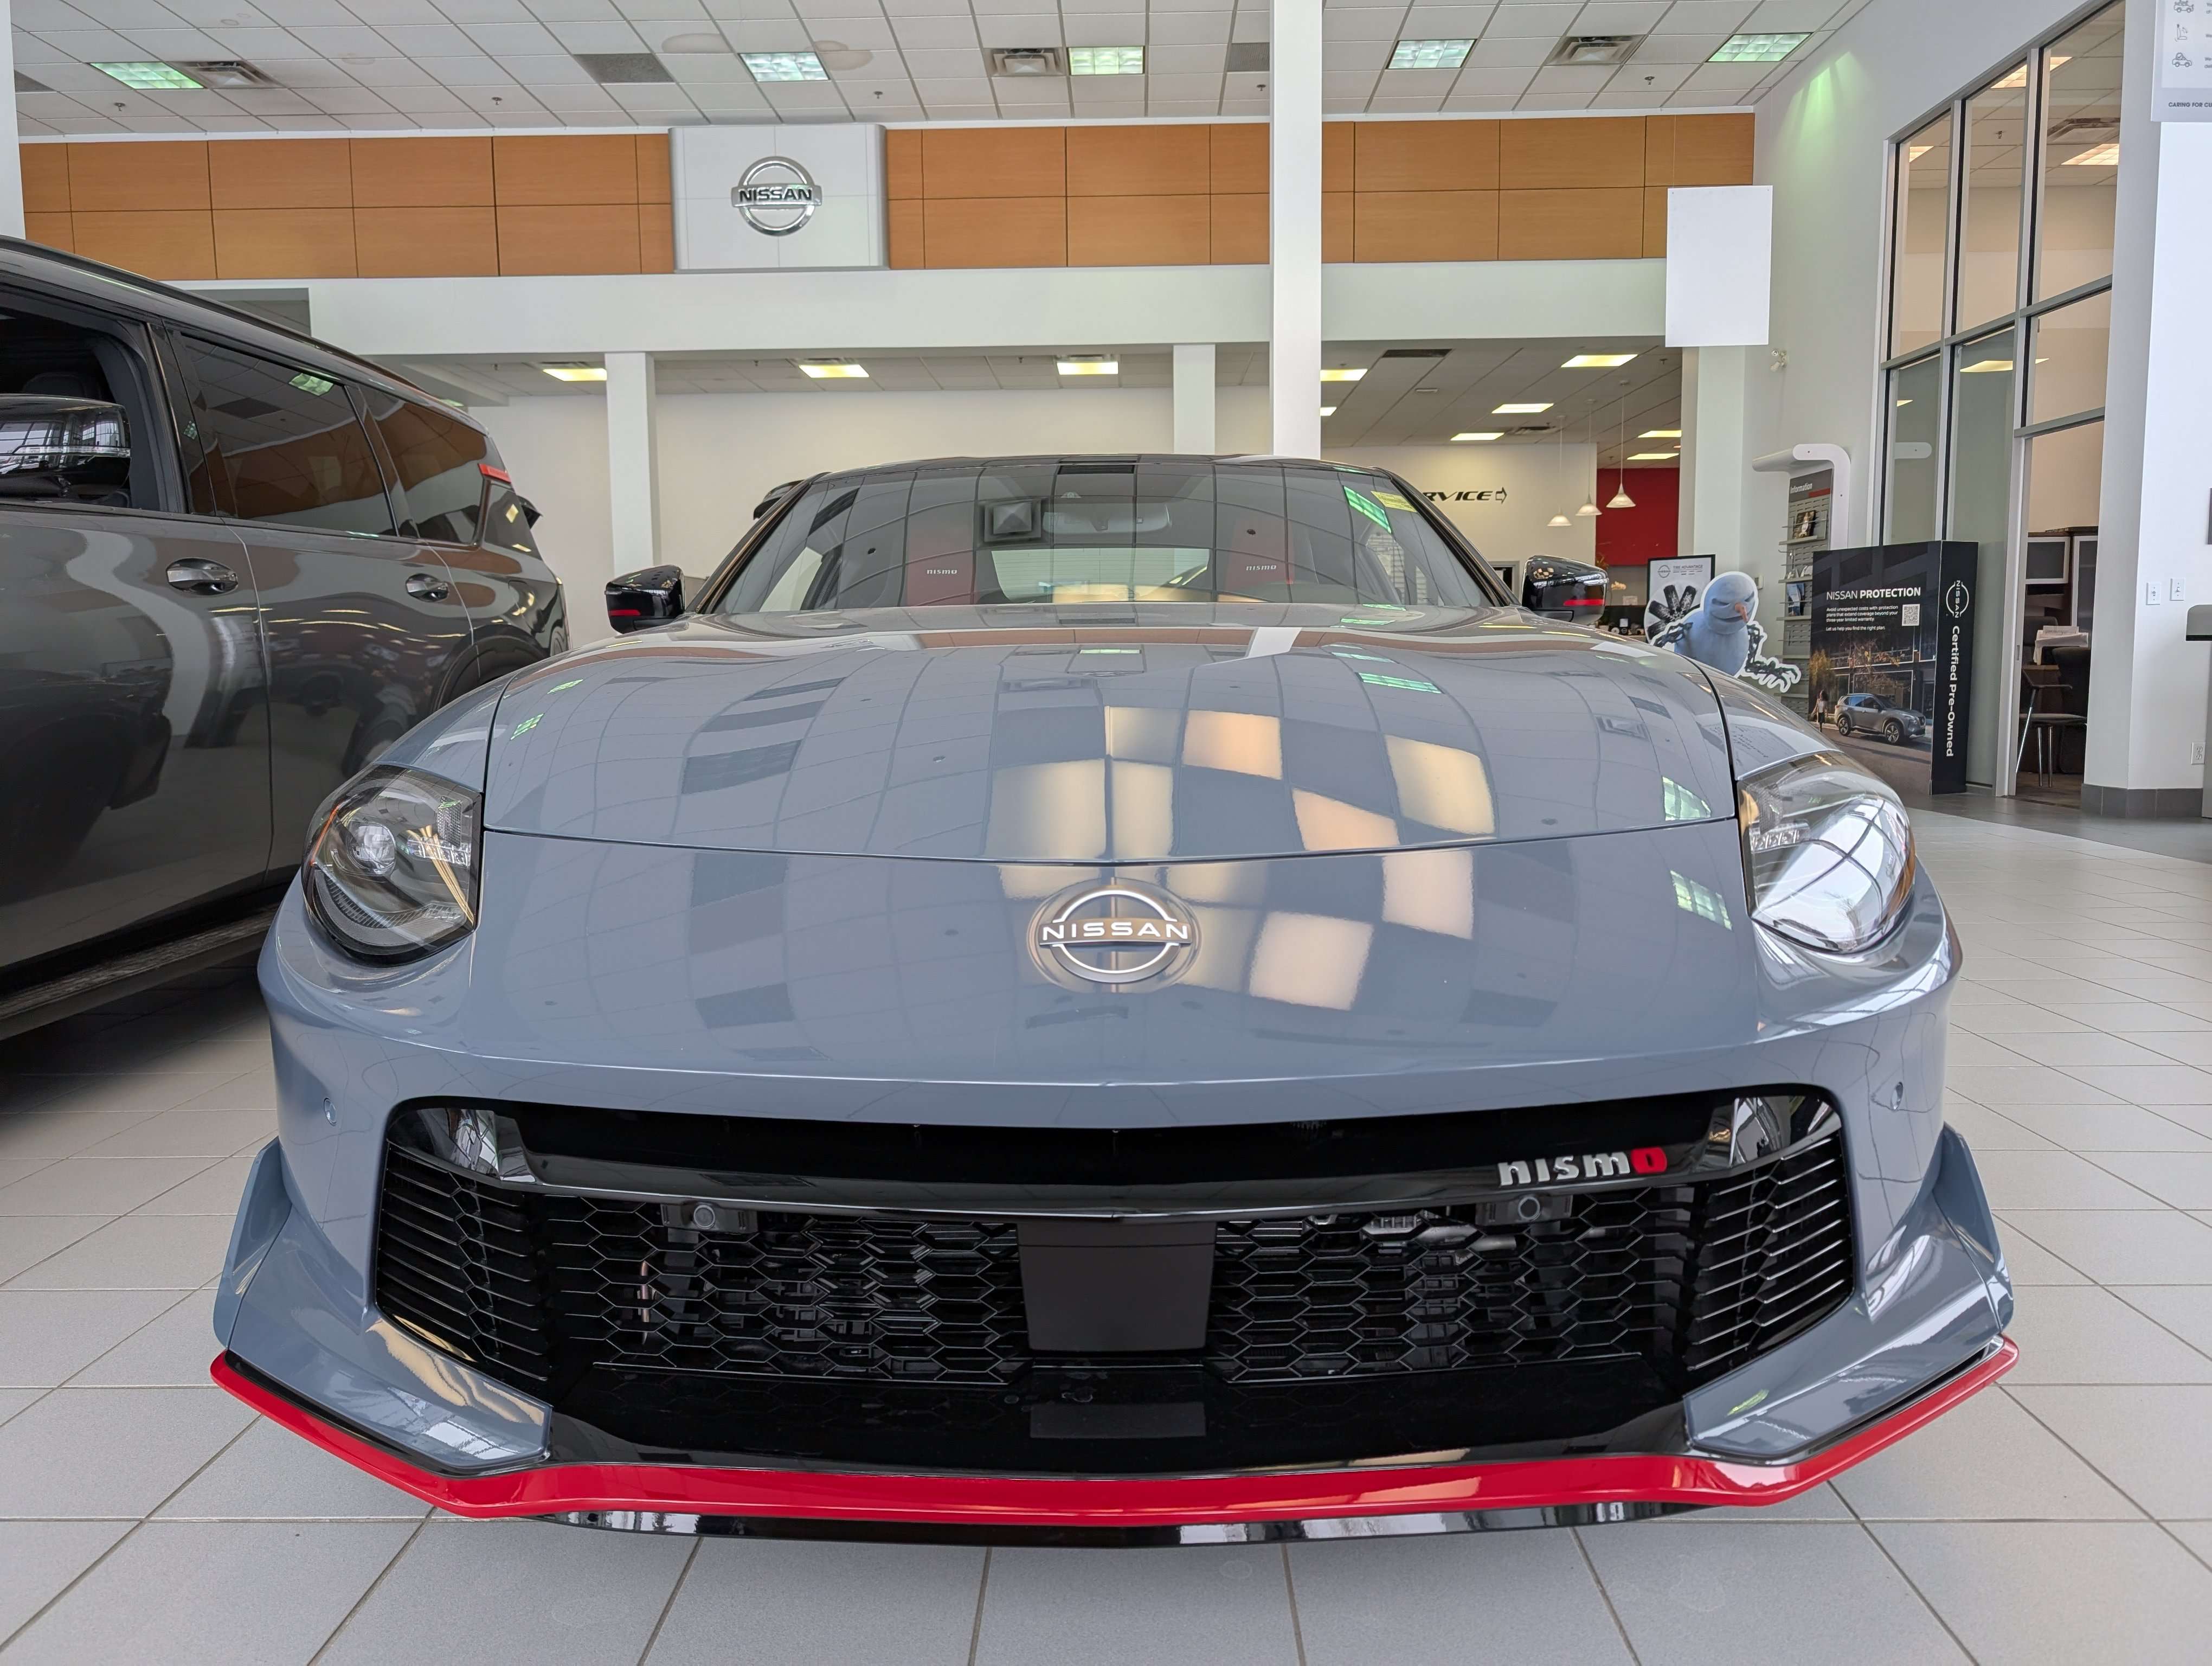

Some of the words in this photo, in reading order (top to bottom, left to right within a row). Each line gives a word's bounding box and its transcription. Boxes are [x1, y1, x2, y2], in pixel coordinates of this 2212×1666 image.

[740, 188, 812, 202] NISSAN
[1790, 482, 1813, 494] Information
[1827, 591, 1857, 600] NISSAN
[1860, 587, 1921, 598] PROTECTION
[1950, 625, 1960, 681] Certified
[1946, 683, 1957, 757] Pre-Owned
[1043, 922, 1188, 941] NISSAN
[1497, 1145, 1668, 1187] nismo
